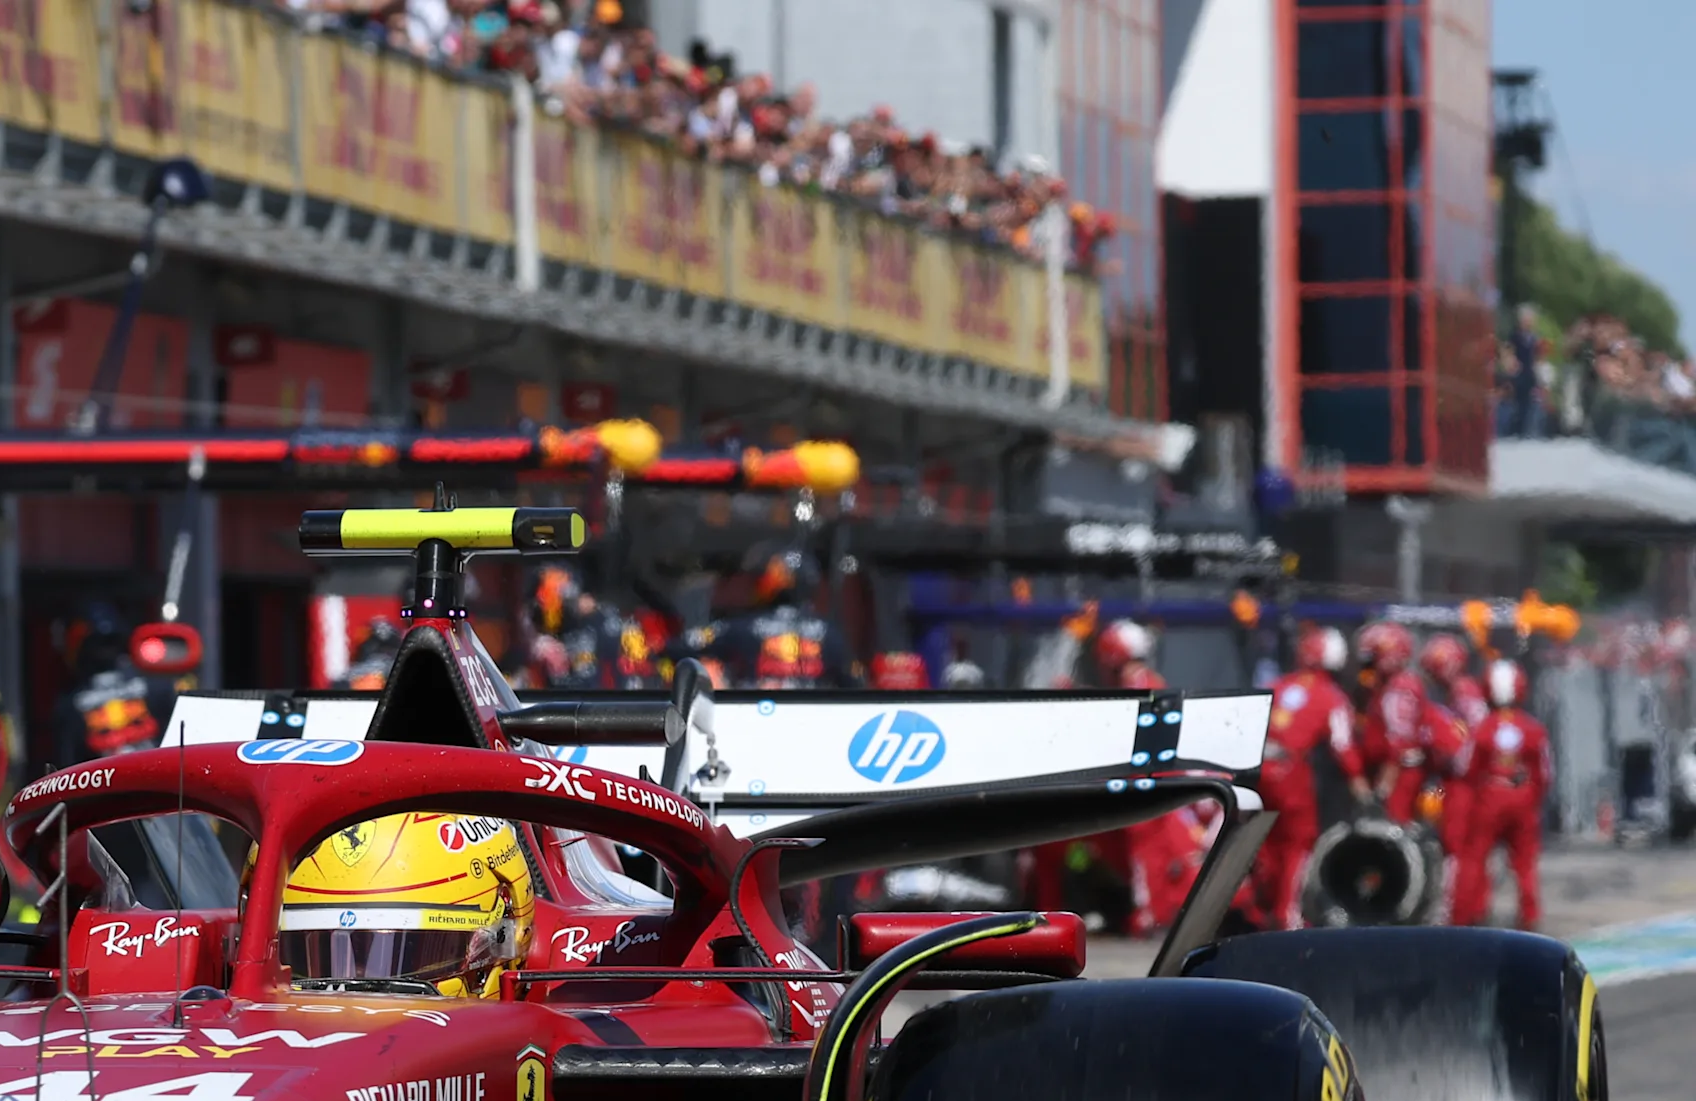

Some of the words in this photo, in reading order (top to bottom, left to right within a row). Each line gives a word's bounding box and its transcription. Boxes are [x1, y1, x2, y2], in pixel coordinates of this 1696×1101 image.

[855, 710, 939, 784] hp
[19, 768, 115, 802] TECHNOLOGY
[520, 757, 596, 801] DXC
[601, 778, 705, 832] TECHNOLOGY
[340, 910, 357, 927] hp
[428, 915, 466, 925] RICHARD
[467, 917, 489, 926] MILLE
[38, 1045, 263, 1058] PLAY
